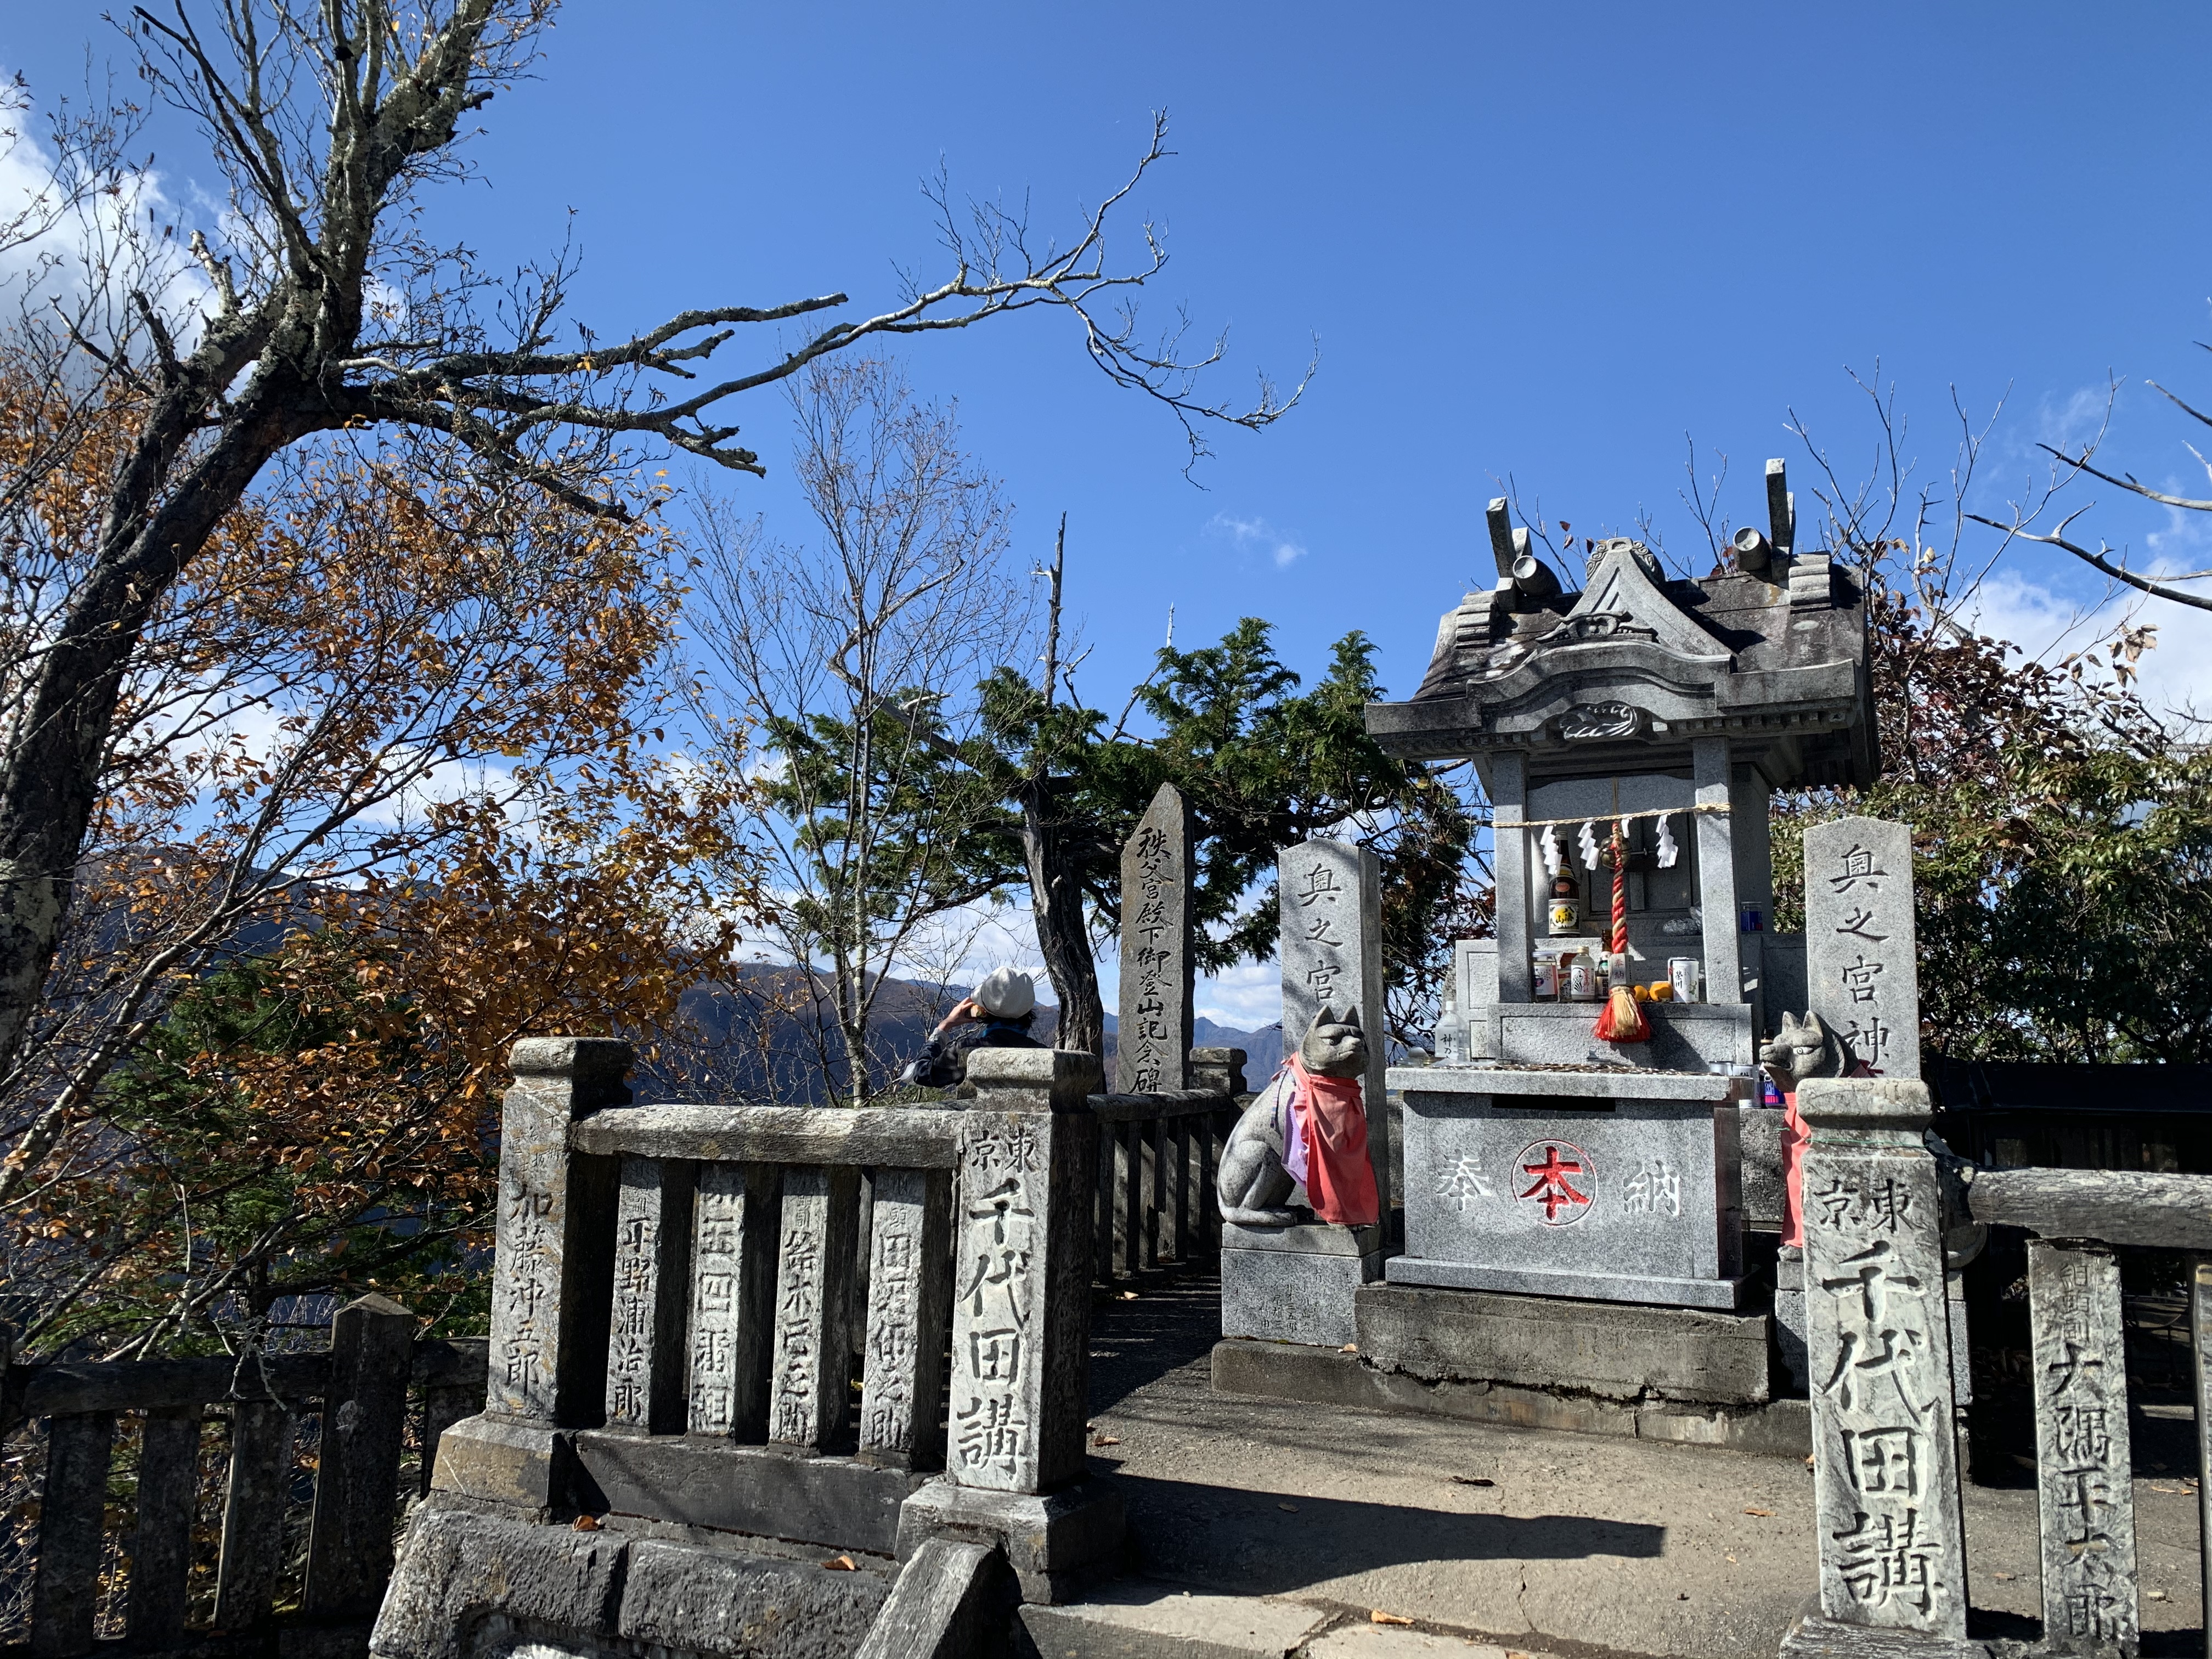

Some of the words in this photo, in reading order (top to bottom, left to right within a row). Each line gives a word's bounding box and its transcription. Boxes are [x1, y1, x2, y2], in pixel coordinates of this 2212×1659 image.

[1440, 1034, 1453, 1059] 神乃
[957, 1177, 1035, 1477] 千代田講
[1820, 1239, 1949, 1621] 千代田講
